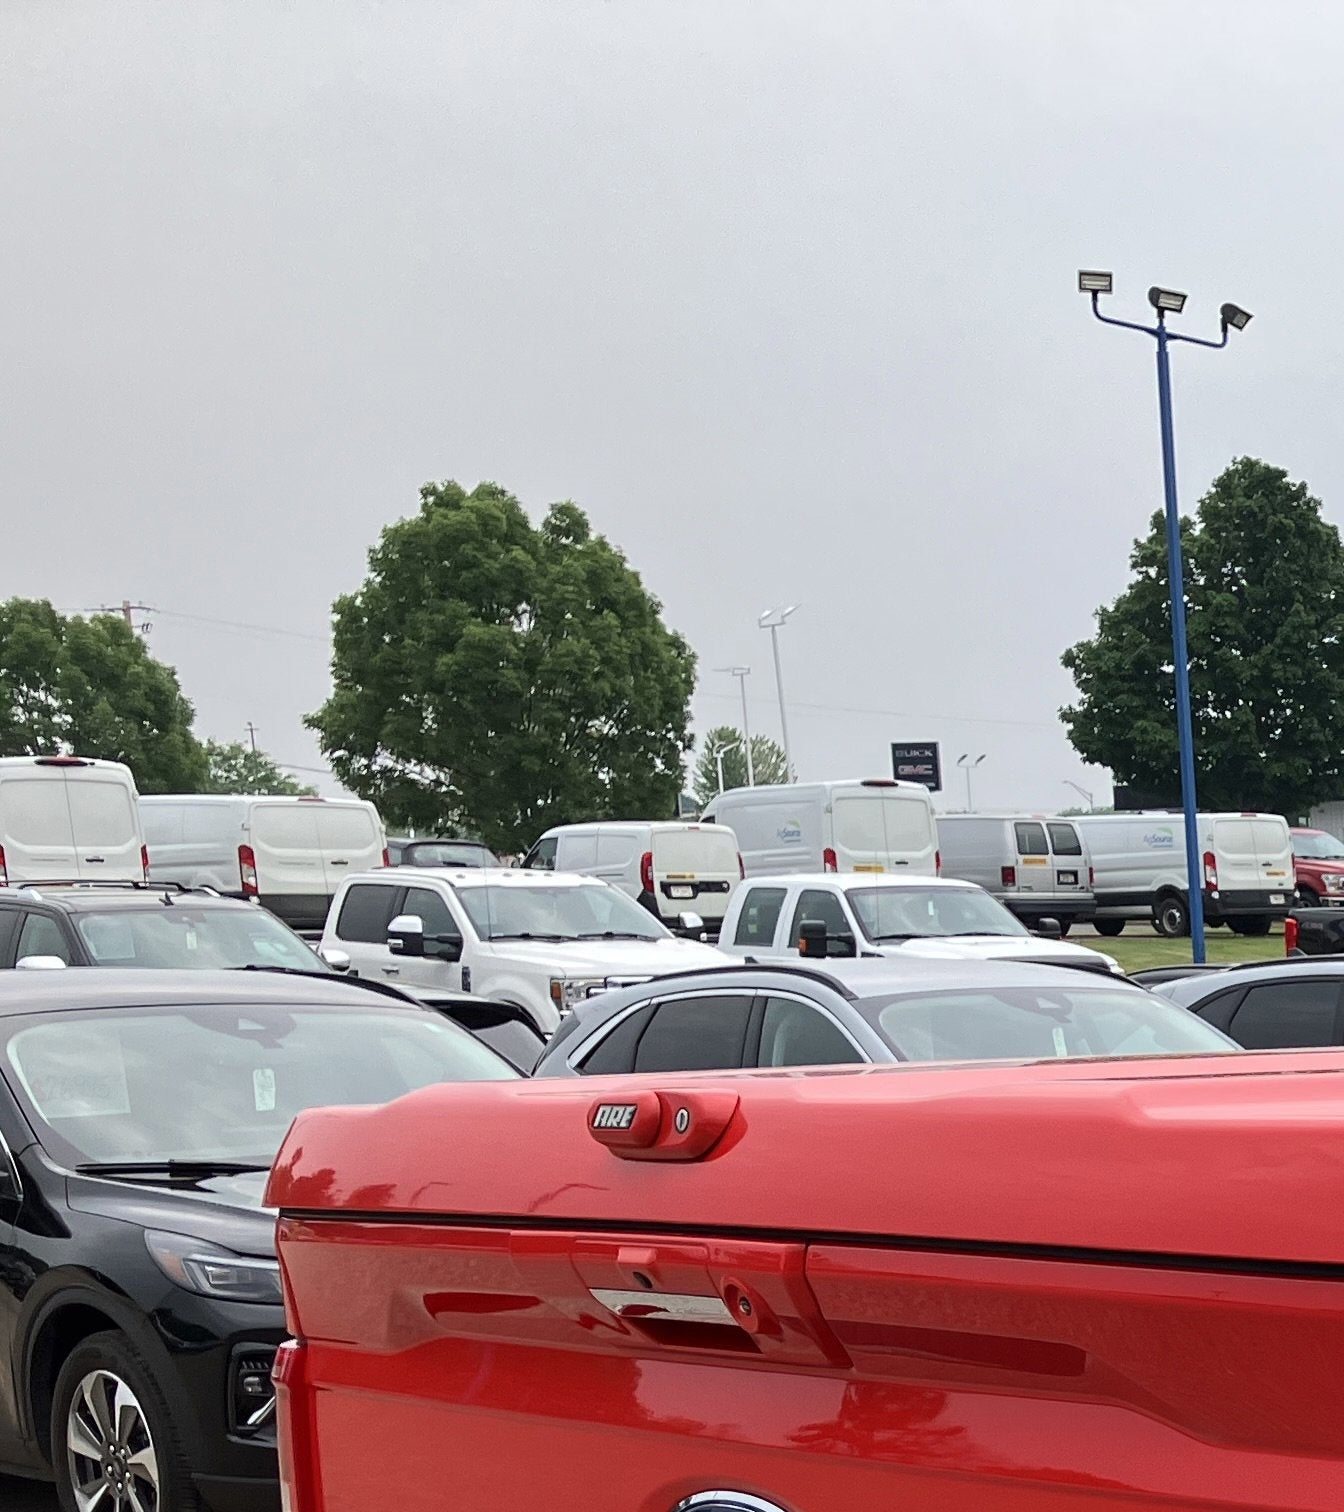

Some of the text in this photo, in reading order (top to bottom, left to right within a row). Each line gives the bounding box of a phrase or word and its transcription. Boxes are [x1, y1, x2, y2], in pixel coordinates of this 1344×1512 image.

[895, 749, 933, 758] BUICK
[898, 764, 933, 775] GMC
[594, 1104, 637, 1128] ARE
